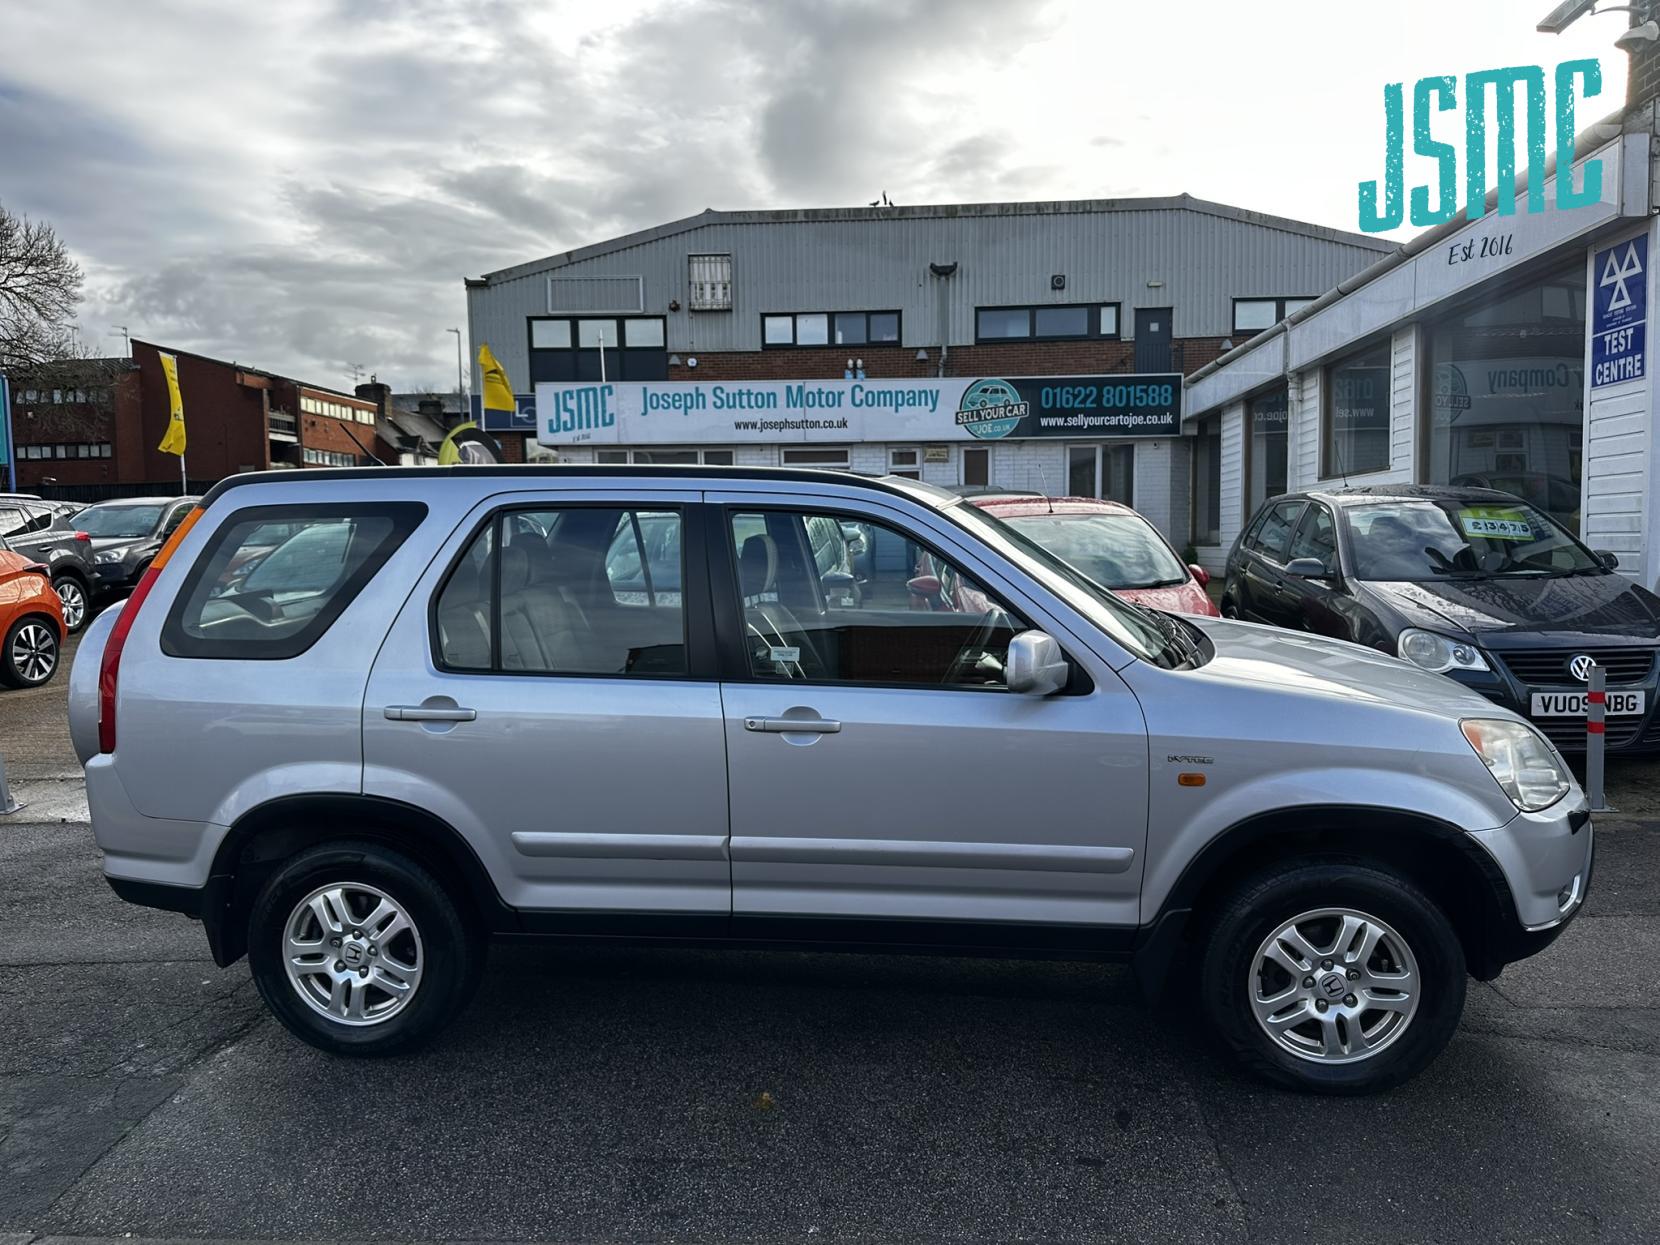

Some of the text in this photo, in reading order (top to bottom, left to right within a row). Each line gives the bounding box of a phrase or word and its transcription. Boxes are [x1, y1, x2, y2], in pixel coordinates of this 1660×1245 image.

[1448, 234, 1513, 265] Est 2016
[1604, 327, 1634, 356] TEST
[1595, 353, 1642, 385] CENTRE
[548, 384, 615, 434] JSMC
[641, 384, 940, 416] Joseph Sutton Motor Company
[1041, 385, 1173, 409] 01622 801588
[734, 417, 849, 433] www.josephsutton.co.uk
[957, 404, 1026, 424] SELL YOUR CAR
[1040, 412, 1173, 429] www.sellyourcartojoe.co.uk
